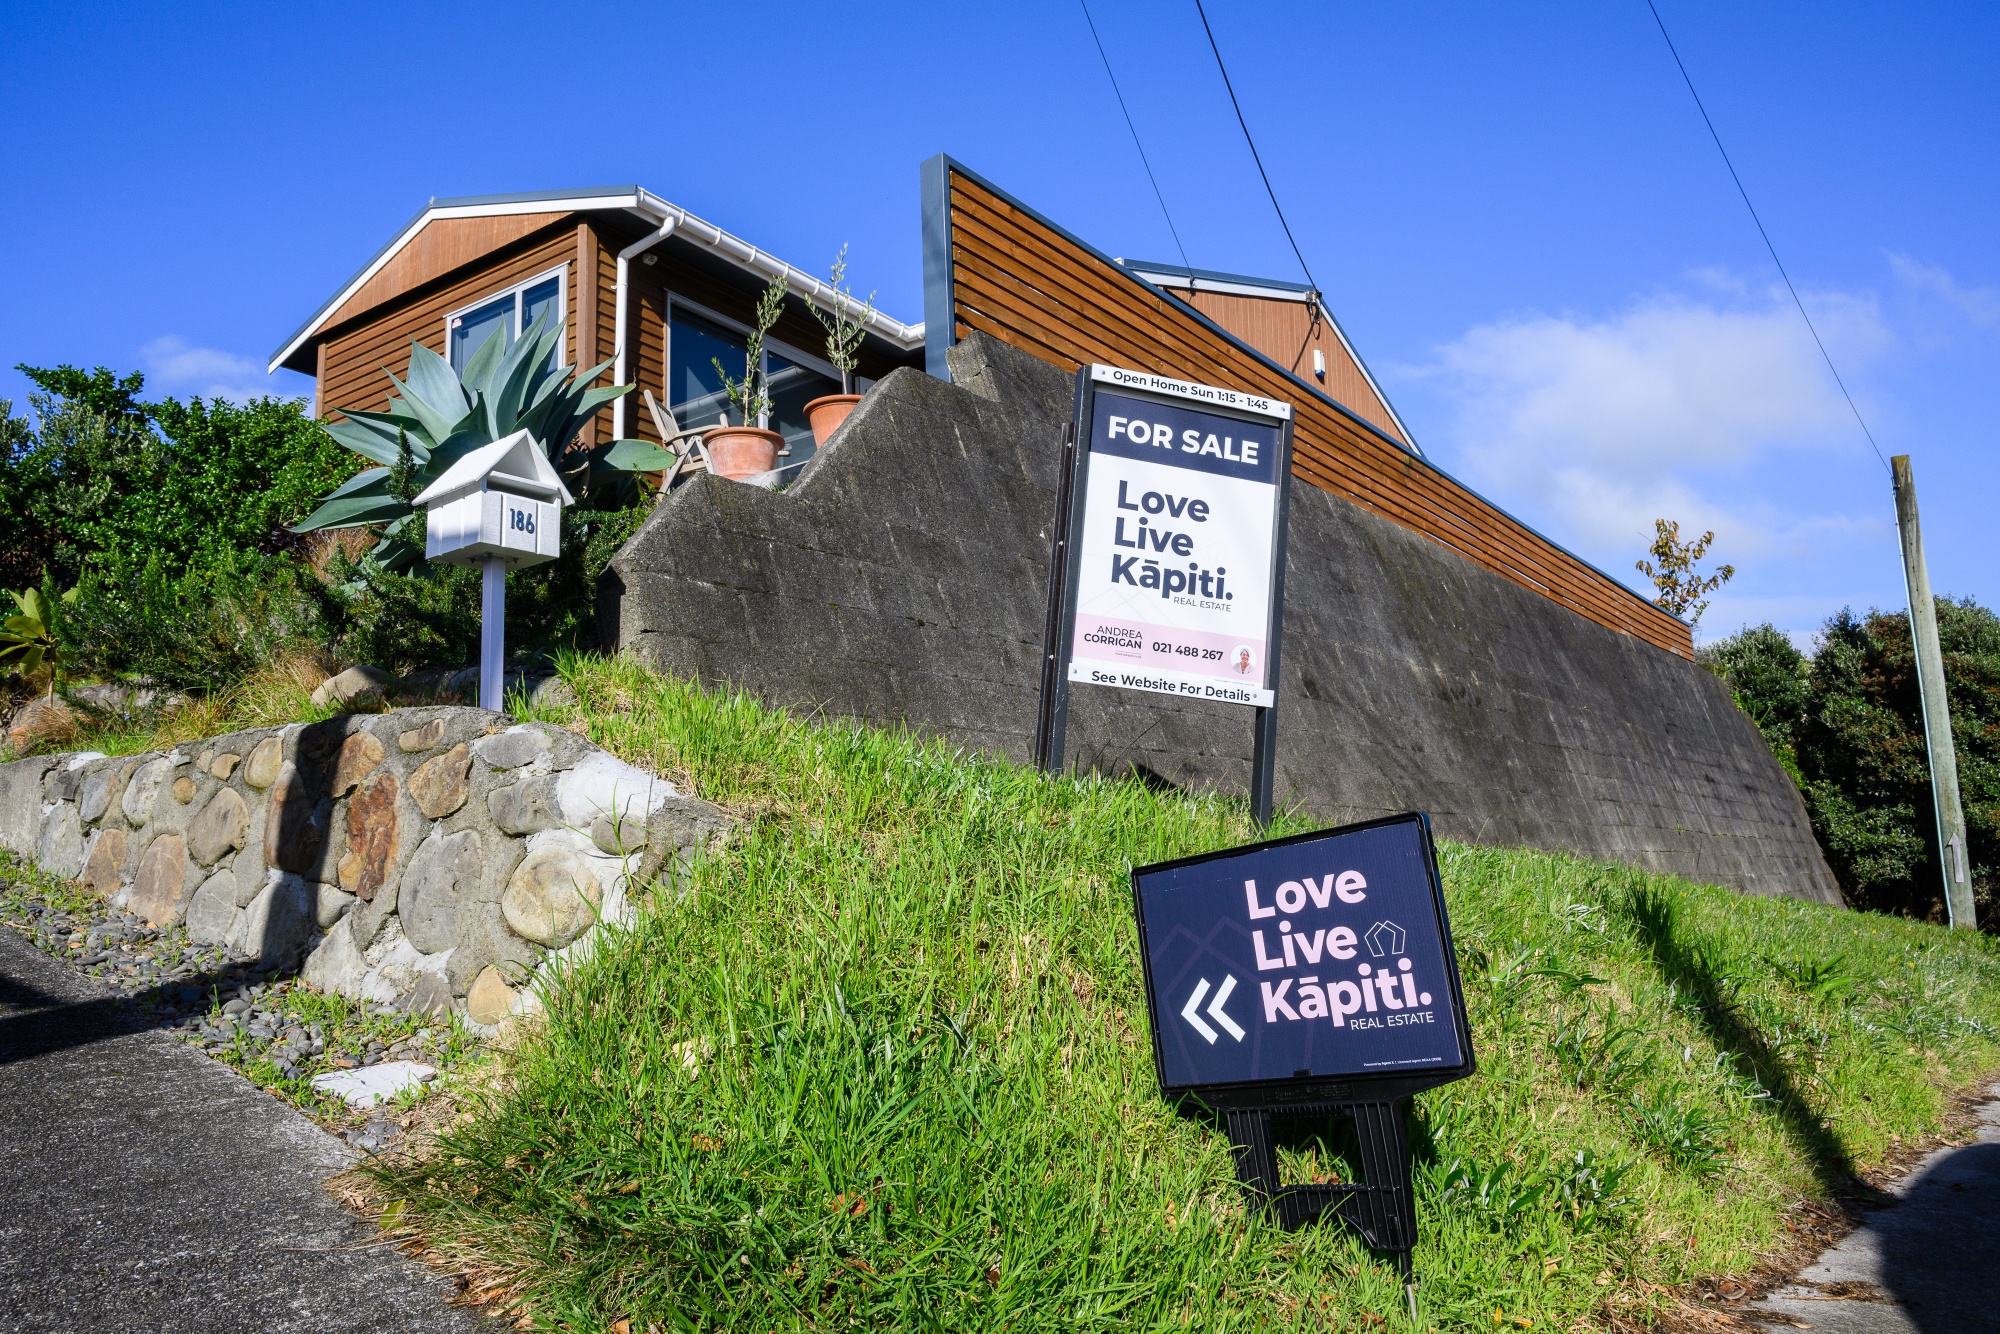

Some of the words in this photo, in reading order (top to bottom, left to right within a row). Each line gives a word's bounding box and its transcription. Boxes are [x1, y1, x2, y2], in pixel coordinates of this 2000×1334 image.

[1113, 370, 1147, 386] Open
[1151, 378, 1187, 394] Home
[1191, 386, 1214, 399] Sun
[1217, 391, 1236, 403] 1:15
[1247, 397, 1268, 410] 1:45
[1108, 415, 1173, 450] FOR
[1181, 429, 1260, 465] SALE
[510, 508, 534, 534] 186
[1117, 480, 1210, 523] Love
[1114, 516, 1194, 556] Live
[1111, 554, 1233, 600] Kāpiti.
[1173, 596, 1197, 607] REAL
[1200, 600, 1232, 612] ESTATE
[1084, 633, 1142, 650] CORRIGAN
[1096, 625, 1142, 640] ANDREA
[1152, 642, 1172, 654] 021
[1175, 645, 1199, 657] 488
[1202, 648, 1224, 660] 267
[1092, 671, 1117, 683] See
[1121, 674, 1176, 692] Website
[1180, 682, 1202, 694] For
[1205, 686, 1251, 702] Details
[1244, 870, 1367, 920] Love
[1252, 920, 1358, 971] Live
[1260, 958, 1432, 1028] Kāpiti.
[1350, 1016, 1384, 1030] REAL
[1388, 1011, 1434, 1027] ESTATE
